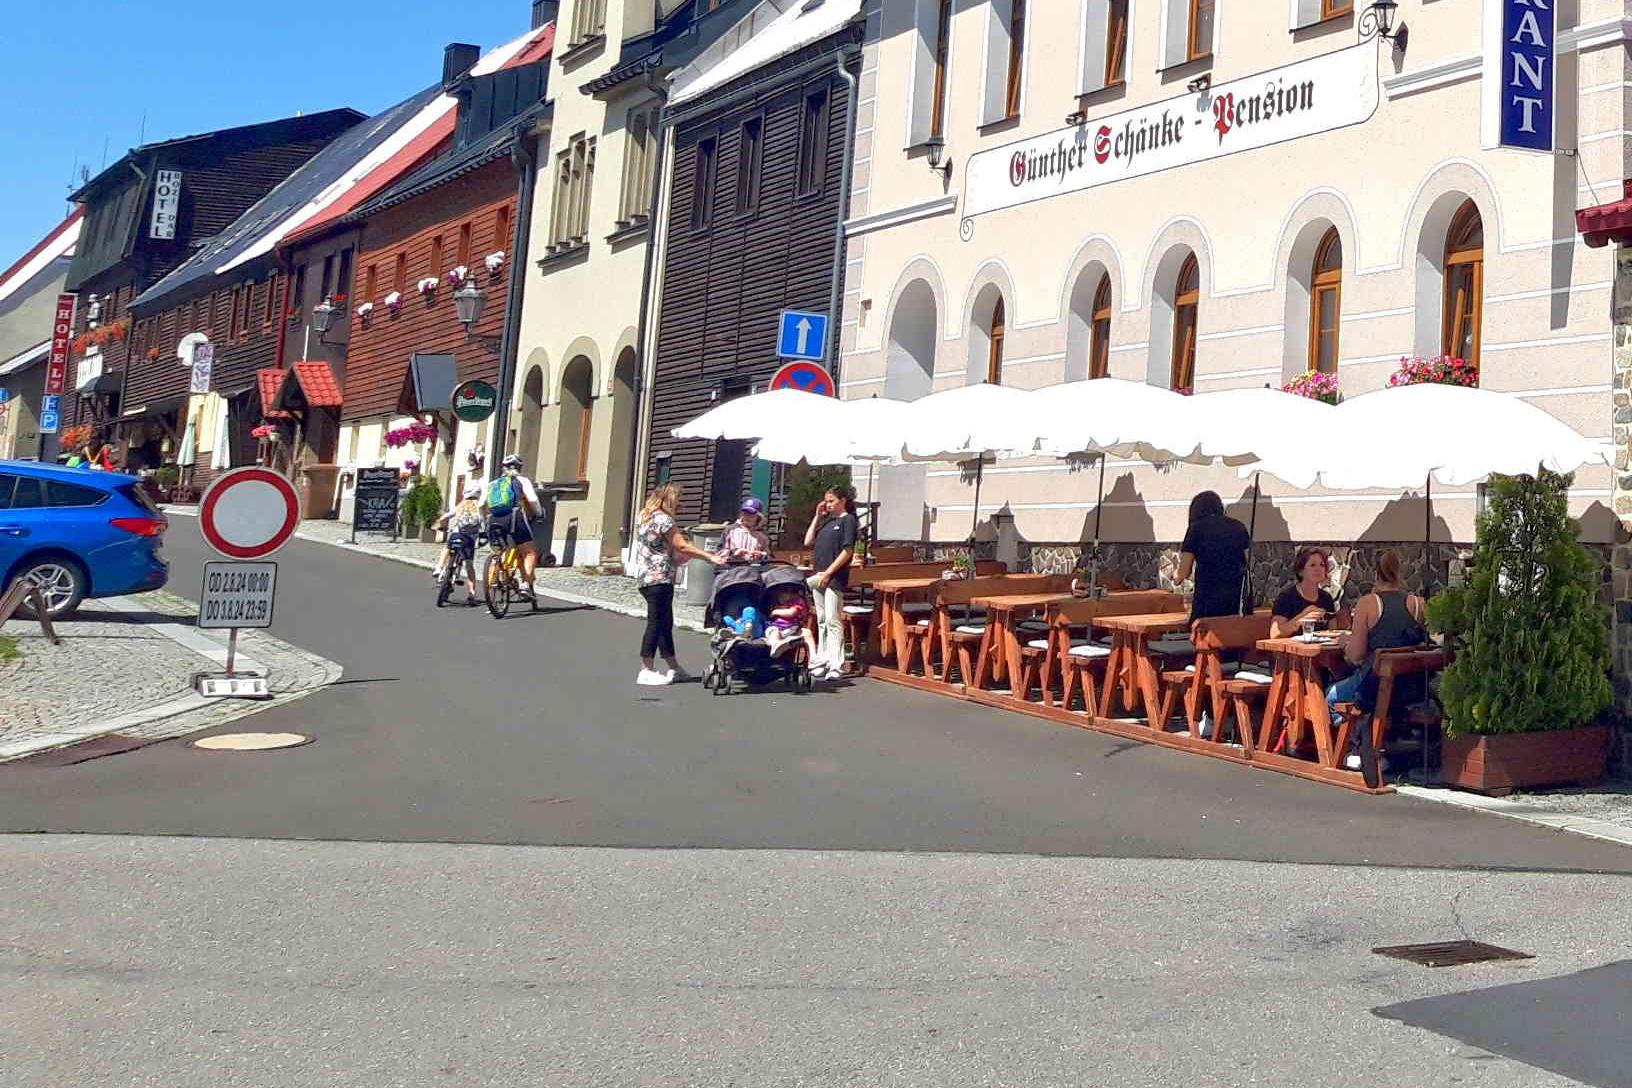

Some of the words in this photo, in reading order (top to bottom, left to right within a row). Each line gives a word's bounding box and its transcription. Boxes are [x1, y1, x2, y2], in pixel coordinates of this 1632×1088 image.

[1009, 138, 1088, 188] Günther
[1093, 108, 1185, 169] Schänke
[1213, 77, 1314, 147] Pension
[154, 171, 171, 237] HOTEL
[51, 309, 71, 379] HOTEL
[206, 599, 221, 620] DO
[208, 572, 222, 593] OD
